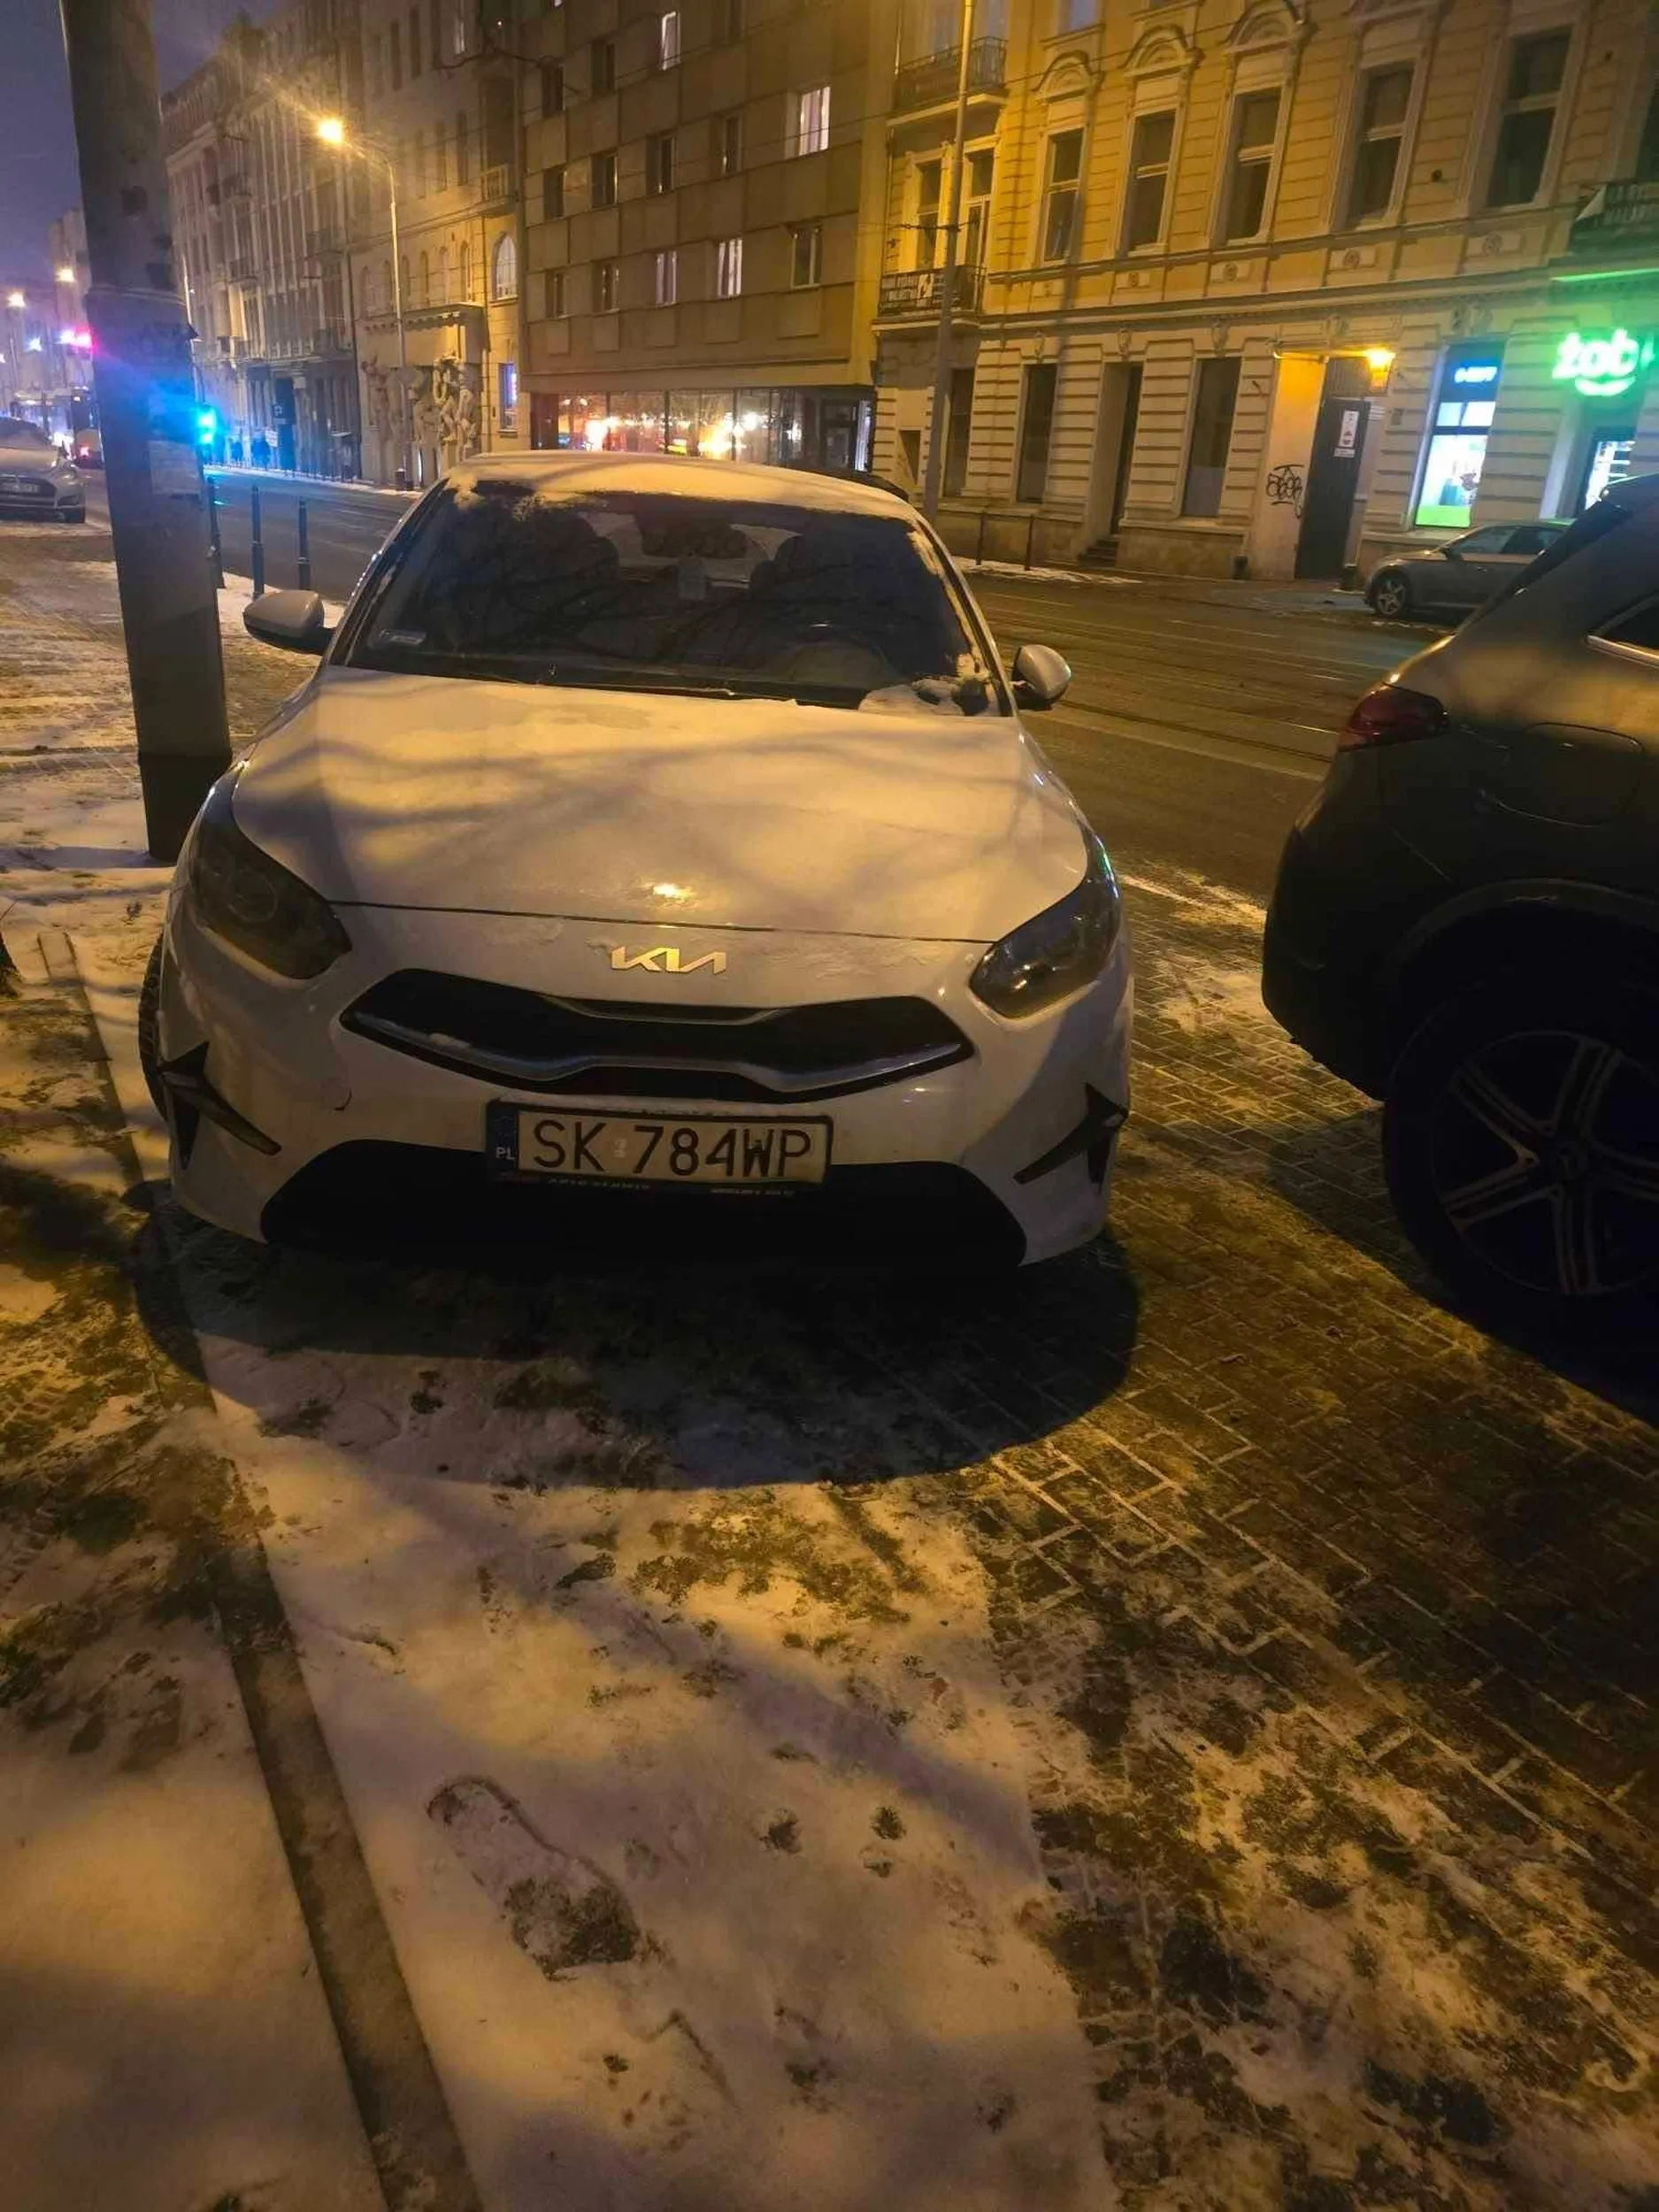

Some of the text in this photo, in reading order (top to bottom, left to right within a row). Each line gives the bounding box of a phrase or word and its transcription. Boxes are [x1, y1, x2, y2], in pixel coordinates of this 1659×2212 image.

[611, 947, 726, 974] KIA
[495, 1146, 515, 1160] PL
[534, 1119, 811, 1177] SK 784WP
